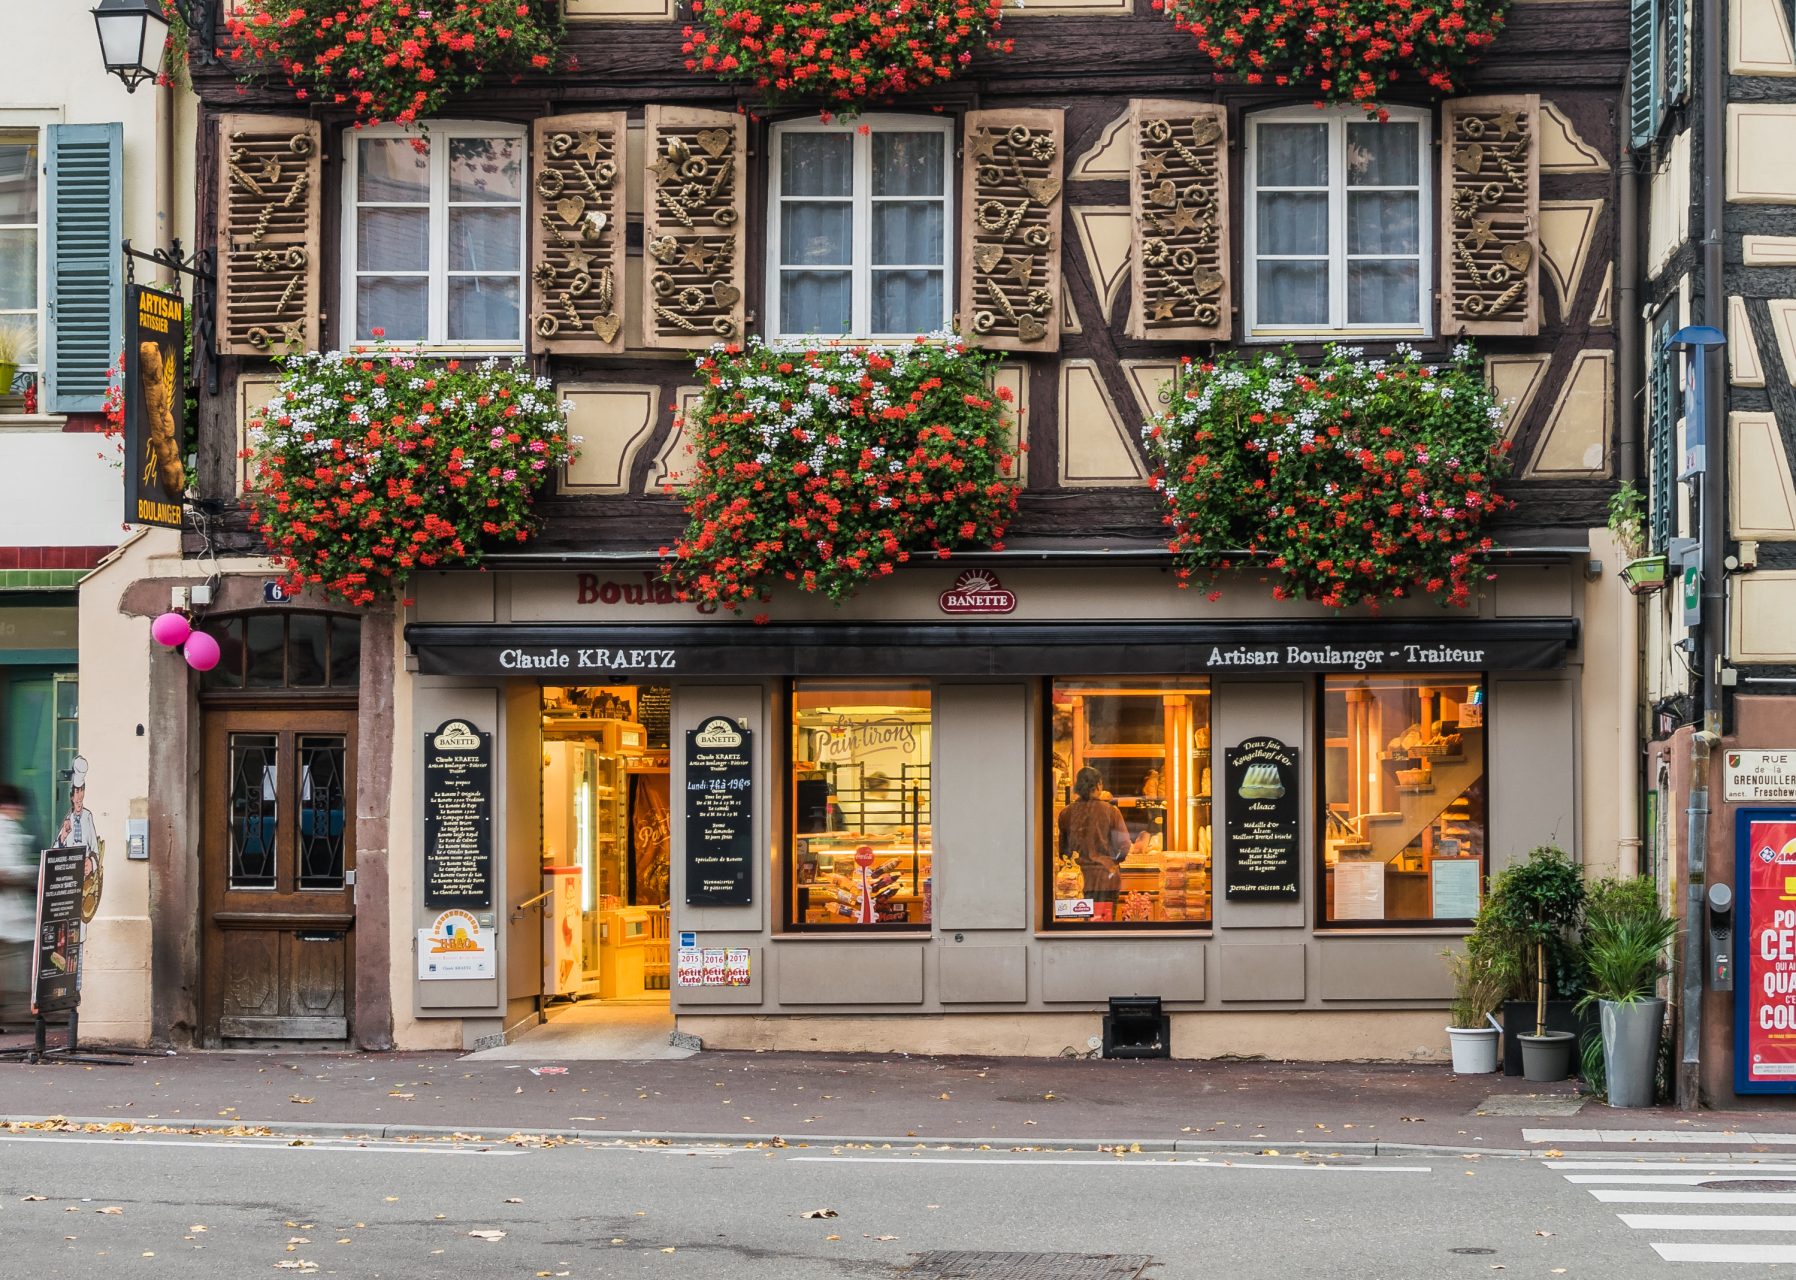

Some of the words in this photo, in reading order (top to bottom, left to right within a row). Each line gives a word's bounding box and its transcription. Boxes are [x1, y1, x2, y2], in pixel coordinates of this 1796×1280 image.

[140, 291, 182, 322] ARTISAN
[140, 312, 168, 334] PATISSIER
[138, 499, 182, 524] BOULANGER
[272, 584, 282, 599] 6
[948, 595, 1008, 606] BANETTE
[500, 648, 570, 668] Claude
[578, 650, 676, 669] KRAETZ
[1206, 646, 1278, 666] Artisan
[1286, 646, 1384, 670] Boulanger
[1404, 645, 1484, 663] Traiteur
[1243, 741, 1266, 750] Deux
[1266, 740, 1281, 750] fois
[1233, 750, 1276, 766] Kougelhopf
[1275, 754, 1292, 766] d'Or
[1755, 787, 1796, 796] Freschew
[1249, 802, 1276, 810] Alsace
[1774, 910, 1796, 928] PO
[1761, 928, 1796, 961] CE
[679, 968, 701, 977] petit
[728, 968, 749, 976] petit
[1776, 962, 1787, 972] QUI
